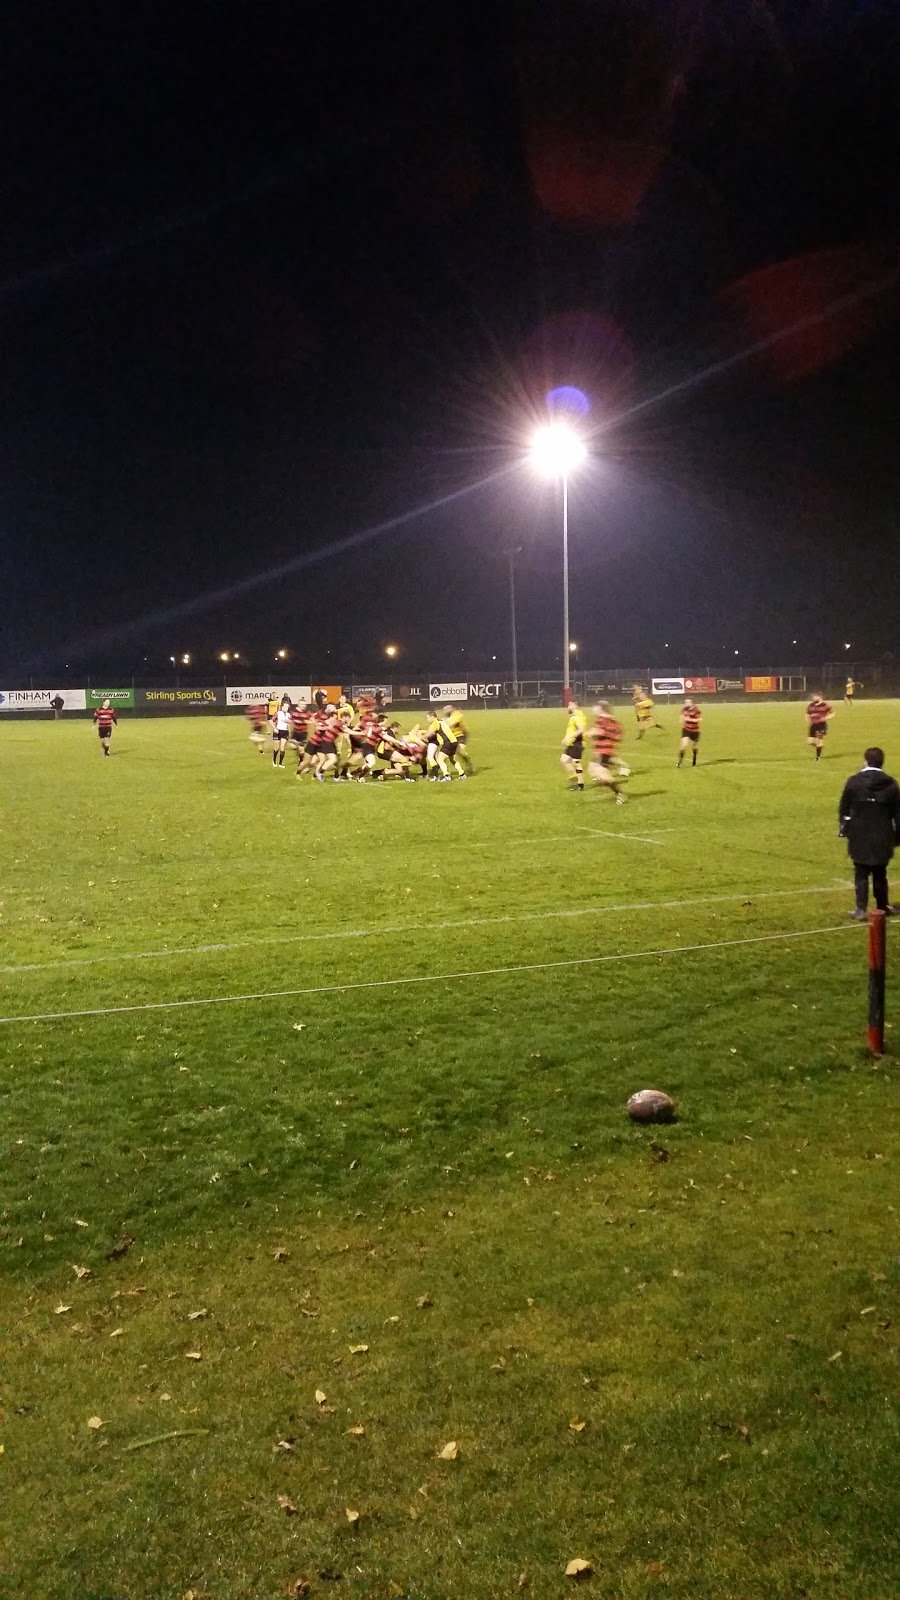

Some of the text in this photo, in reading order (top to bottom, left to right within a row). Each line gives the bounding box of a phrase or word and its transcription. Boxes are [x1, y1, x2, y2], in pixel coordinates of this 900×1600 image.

[469, 684, 501, 696] NZCT
[8, 692, 51, 700] FINHAM
[146, 691, 201, 701] Stirling Sports
